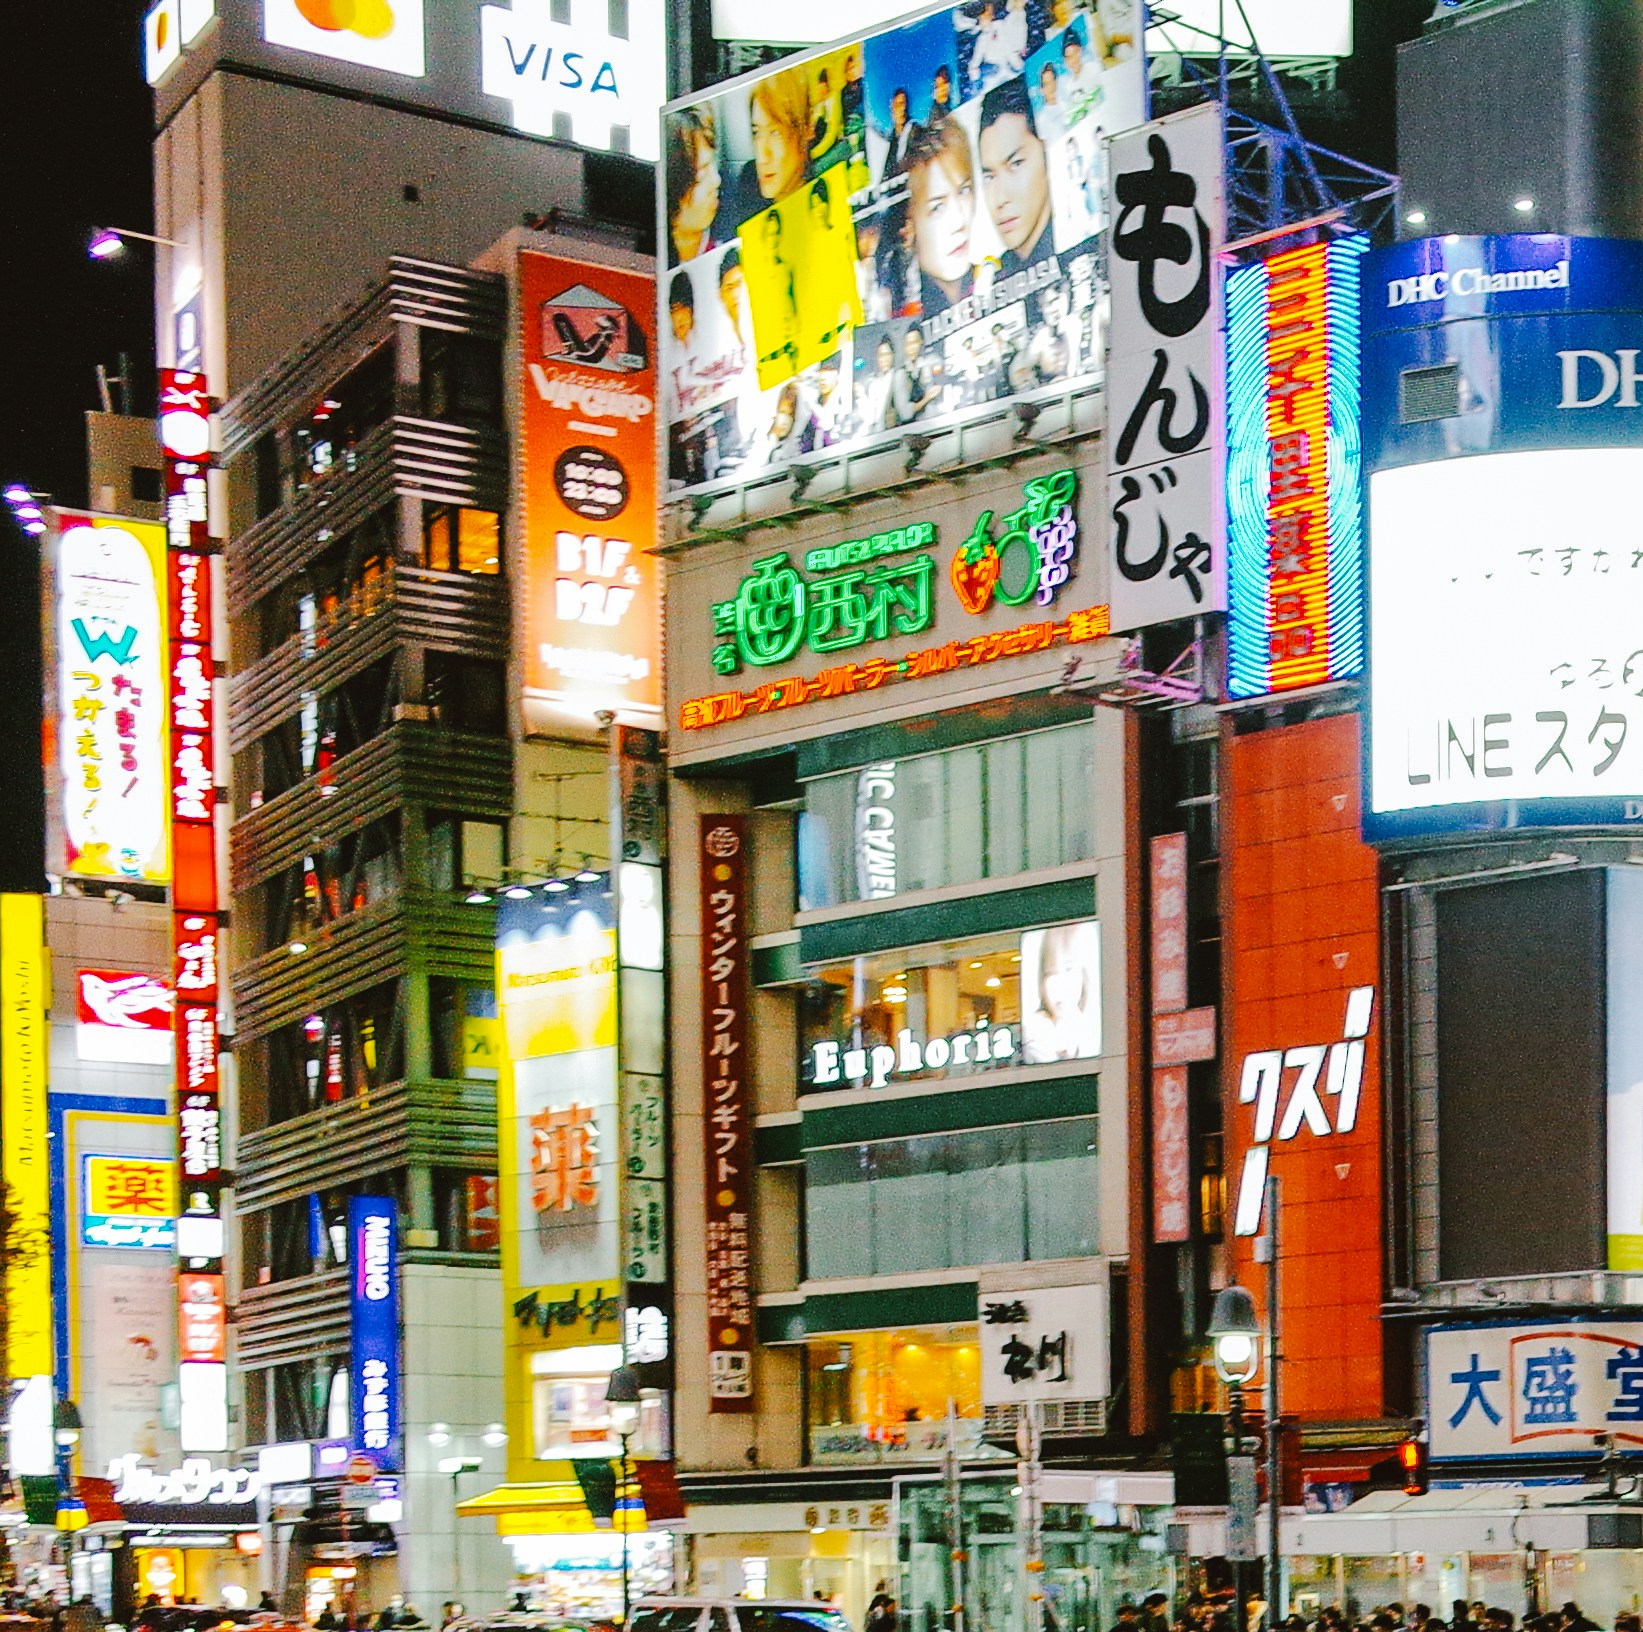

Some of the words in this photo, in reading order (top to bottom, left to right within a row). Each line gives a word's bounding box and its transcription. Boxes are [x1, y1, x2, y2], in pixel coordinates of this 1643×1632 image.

[502, 36, 620, 98] VISA
[1387, 267, 1450, 307] DHC
[1451, 261, 1571, 297] Channel
[1113, 134, 1212, 603] もんじゃ
[556, 531, 632, 577] B1F
[809, 554, 934, 653] 西村
[71, 617, 138, 666] W
[1407, 714, 1514, 787] LINE
[812, 1018, 1016, 1090] Euphoria
[1234, 985, 1375, 1237] クスリ
[106, 1162, 164, 1213] 薬
[529, 1100, 602, 1213] 薬
